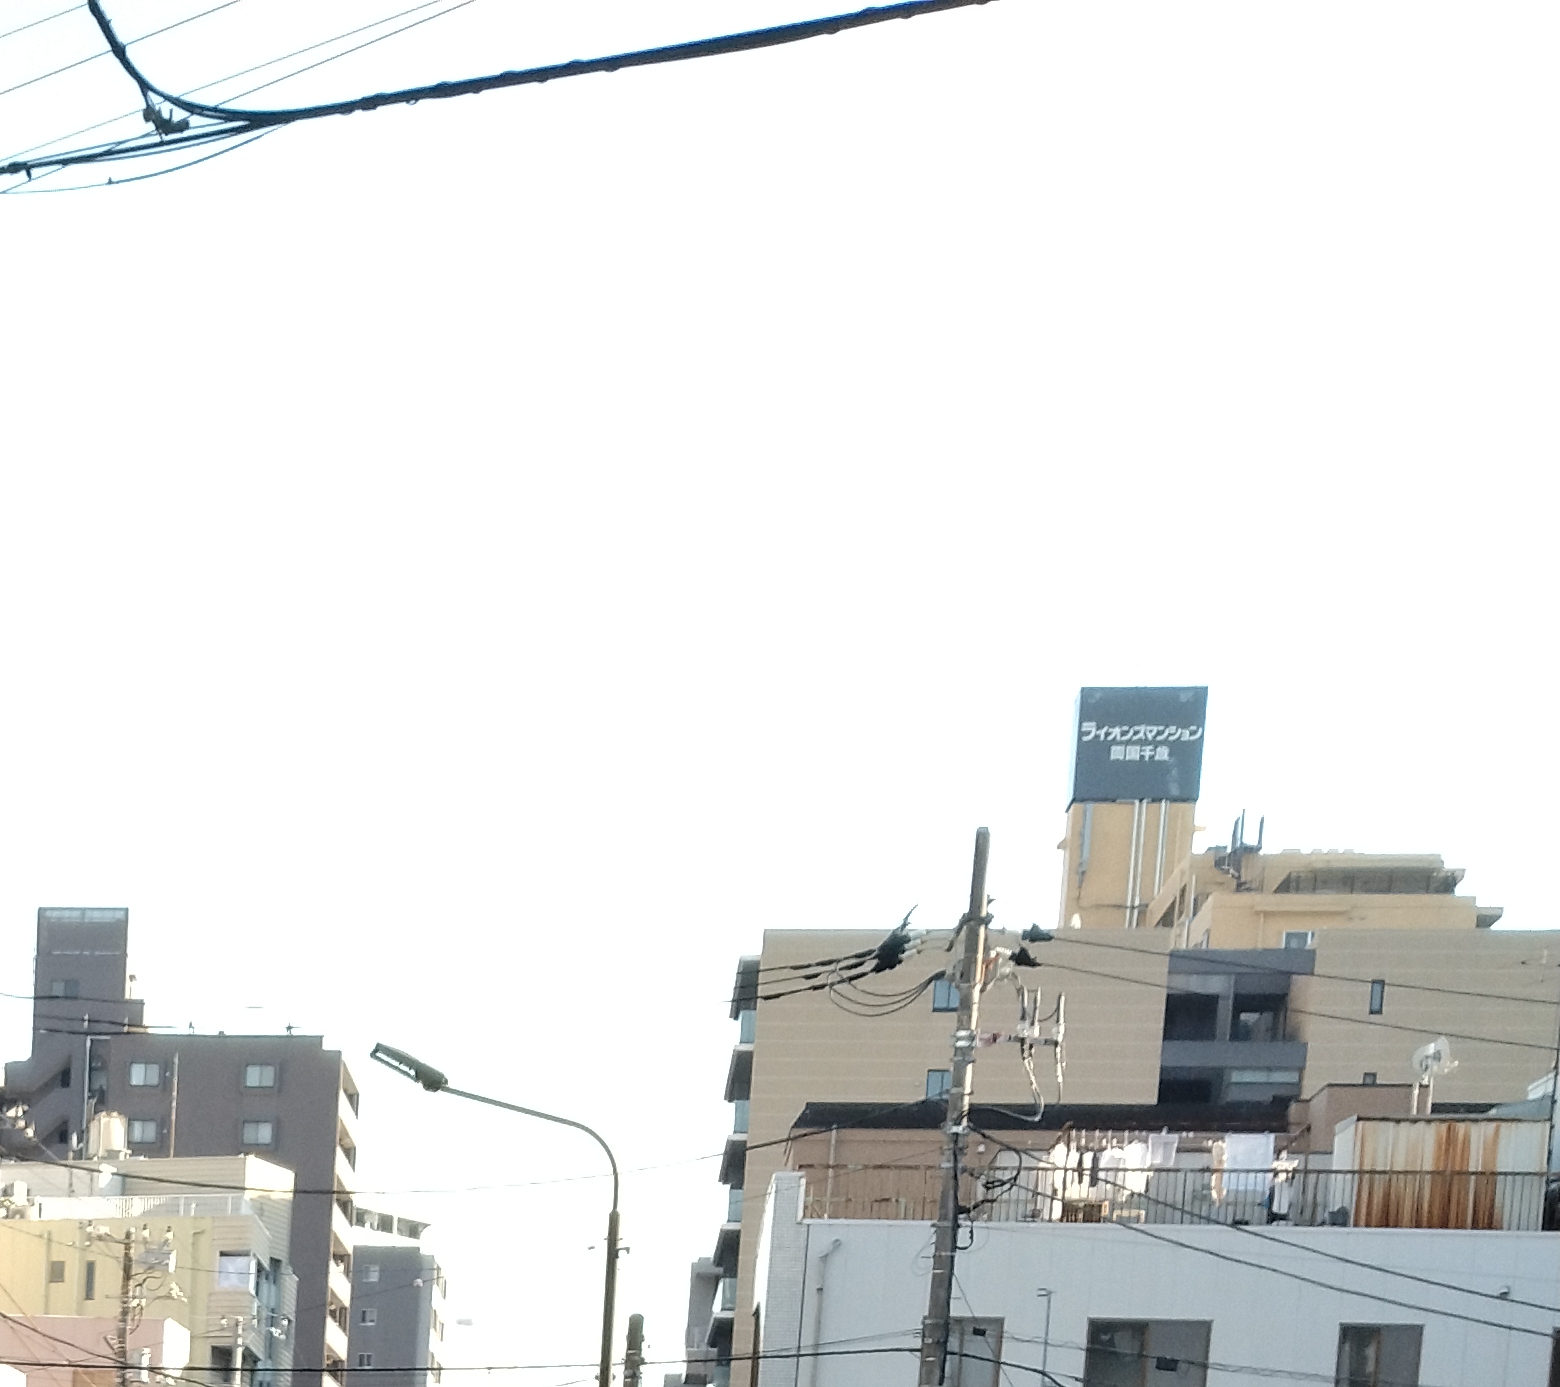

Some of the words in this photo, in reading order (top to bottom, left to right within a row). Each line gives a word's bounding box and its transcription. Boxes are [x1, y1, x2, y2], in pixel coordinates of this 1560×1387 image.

[1081, 721, 1203, 742] ライオンズマンション
